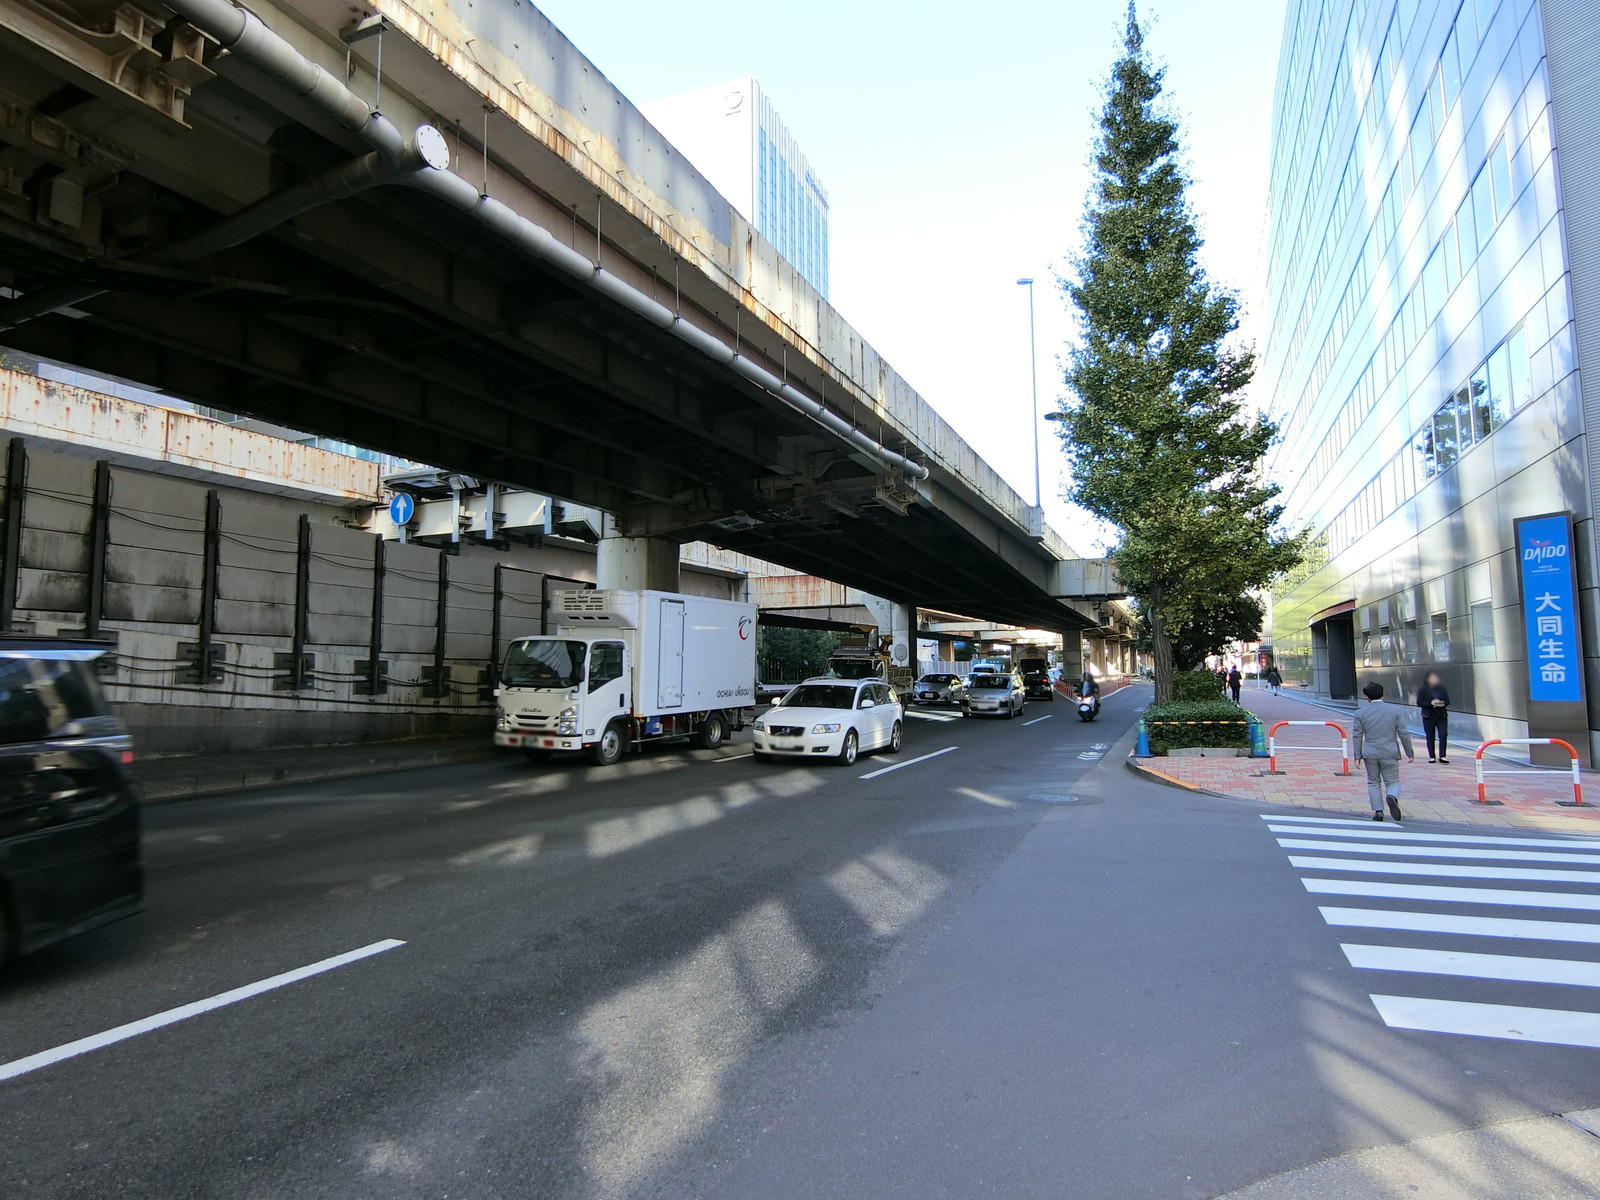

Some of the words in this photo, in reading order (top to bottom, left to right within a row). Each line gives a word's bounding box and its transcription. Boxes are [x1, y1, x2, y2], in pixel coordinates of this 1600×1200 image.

[1524, 544, 1566, 563] DAIDO
[1535, 592, 1566, 683] 大同生命
